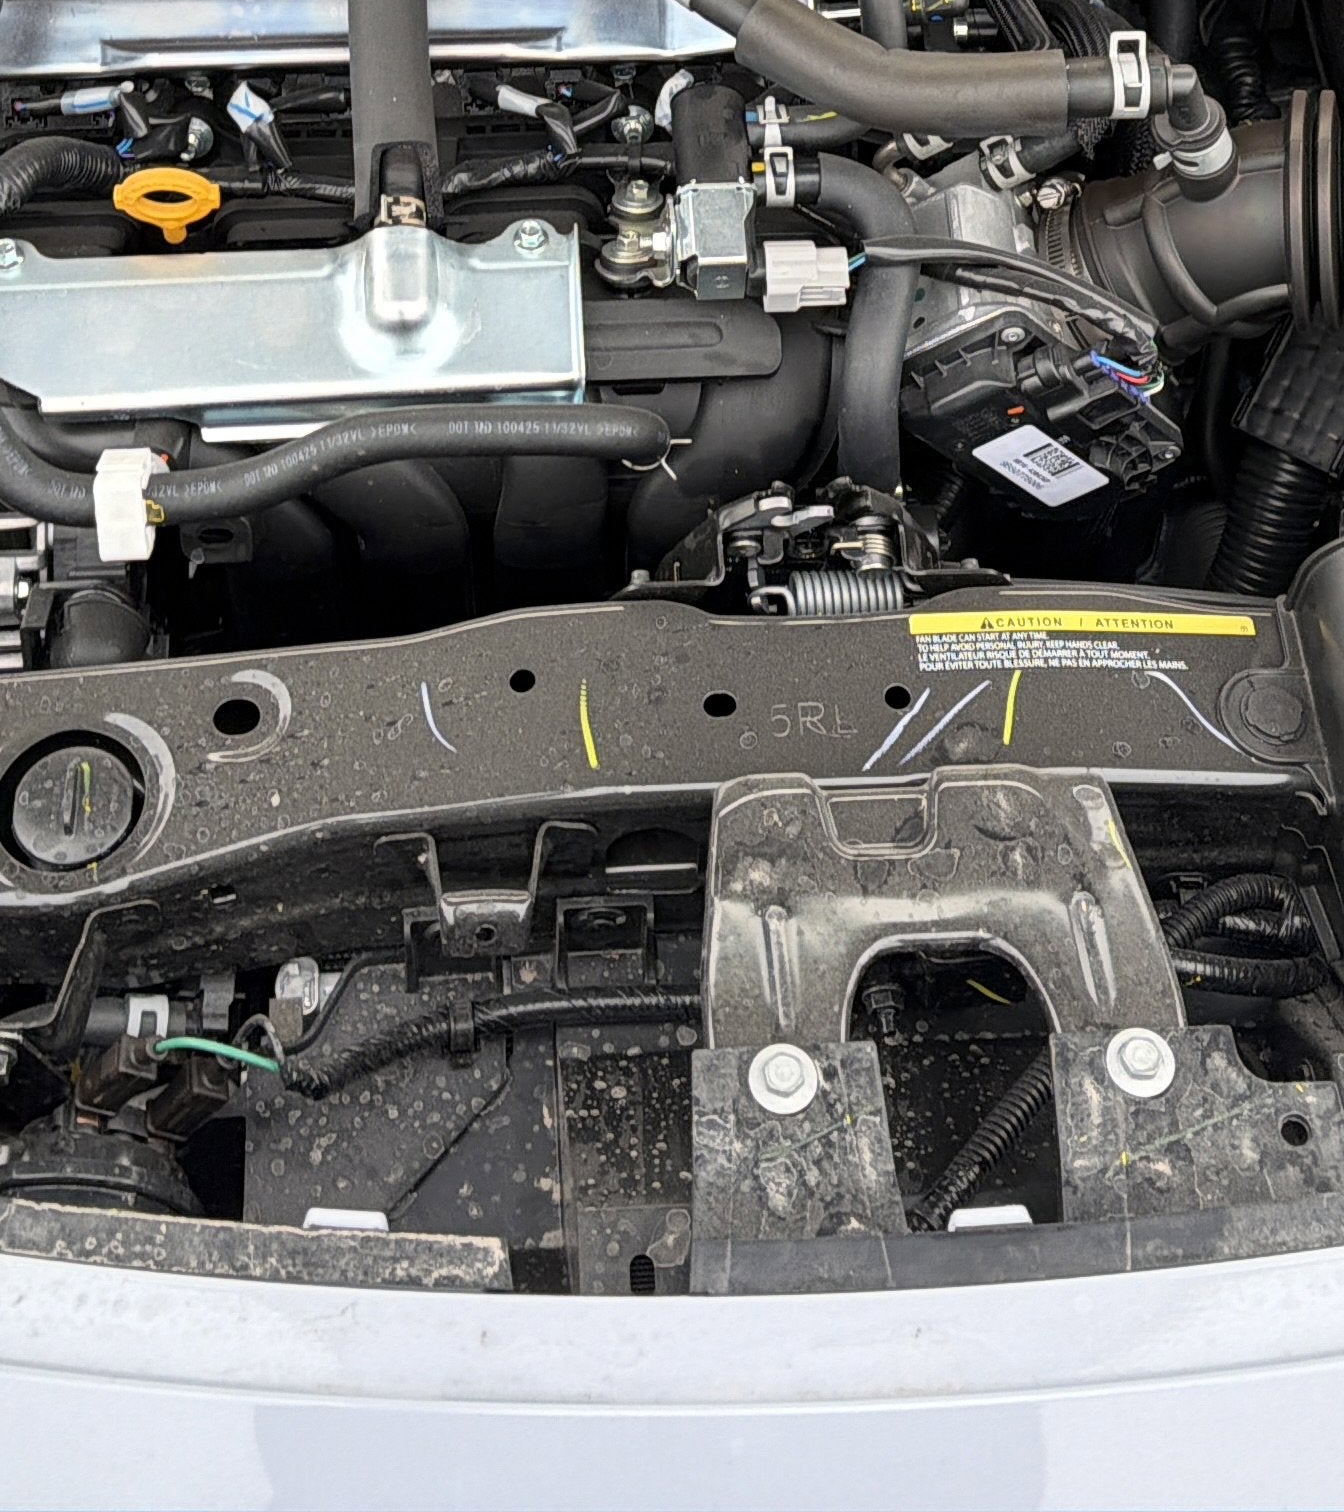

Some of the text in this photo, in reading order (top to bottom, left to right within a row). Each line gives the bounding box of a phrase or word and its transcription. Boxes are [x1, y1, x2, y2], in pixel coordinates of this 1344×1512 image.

[448, 421, 469, 435] DOT
[497, 421, 540, 434] 100425
[244, 471, 261, 488] DOT
[280, 445, 317, 471] 100425
[370, 422, 417, 437] >EPDM<
[996, 617, 1063, 628] CAUTION
[1095, 618, 1174, 629] ATTENTION
[916, 631, 1050, 643] FAN BLADE CAN START AT ANY TIME.
[917, 643, 929, 653] TO
[929, 643, 950, 653] HELP
[950, 643, 975, 652] AVOID
[975, 641, 1015, 651] PERSONAL
[1046, 640, 1065, 648] KEEP
[1066, 640, 1093, 650] HANDS
[1094, 641, 1120, 650] CLEAR.
[918, 653, 929, 662] LE
[929, 651, 986, 661] VENTILATEUR
[986, 650, 1017, 660] RISQUE
[1018, 650, 1031, 658] DE
[1086, 649, 1110, 659] TOUT
[1110, 650, 1151, 660] MOMENT.
[920, 662, 944, 672] POUR
[975, 660, 1002, 669] TOUTE
[1048, 659, 1061, 668] NE
[1062, 659, 1077, 667] PAS
[1078, 659, 1090, 668] EN
[1090, 659, 1143, 670] APPROCHER
[1142, 660, 1158, 670] LES
[1158, 661, 1189, 671] MAINS.
